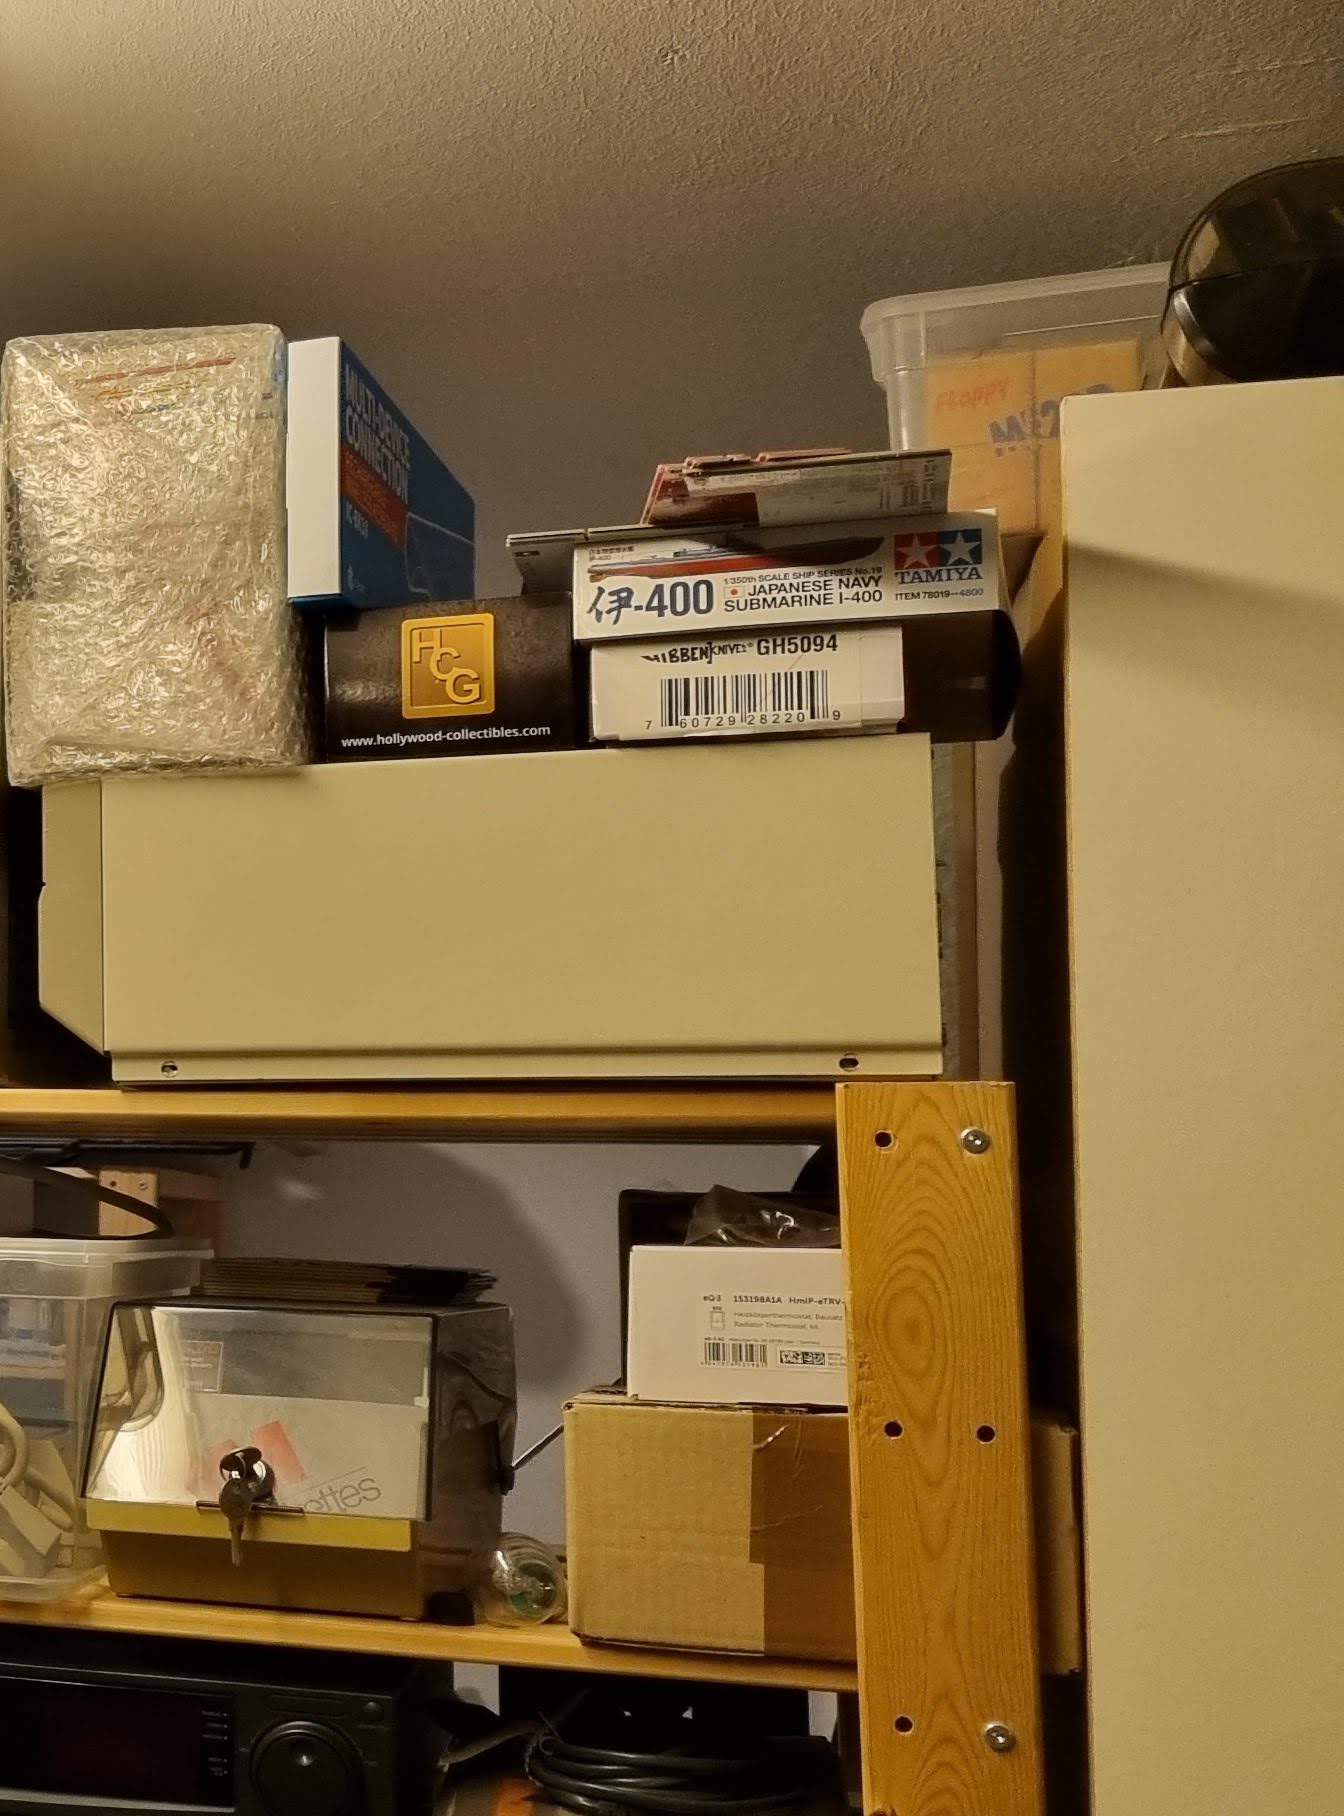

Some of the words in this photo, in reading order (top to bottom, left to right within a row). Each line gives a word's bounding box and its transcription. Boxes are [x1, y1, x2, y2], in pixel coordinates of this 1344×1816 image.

[758, 573, 790, 583] SCALE
[792, 571, 816, 580] SHIP
[817, 569, 853, 578] SERIES
[854, 566, 883, 576] No.19
[895, 567, 983, 585] TAMIYA
[747, 578, 833, 597] JAPANESE
[838, 575, 882, 591] NAVY
[895, 592, 921, 601] ITEM
[586, 578, 714, 625] 伊-400
[724, 593, 833, 612] SUBMARINE
[838, 590, 883, 604] I-400
[757, 635, 839, 656] GH5094
[412, 629, 481, 703] HCG
[645, 720, 652, 731] 7
[832, 710, 841, 721] 9
[341, 725, 551, 748] www.hollywood-collectibles.com
